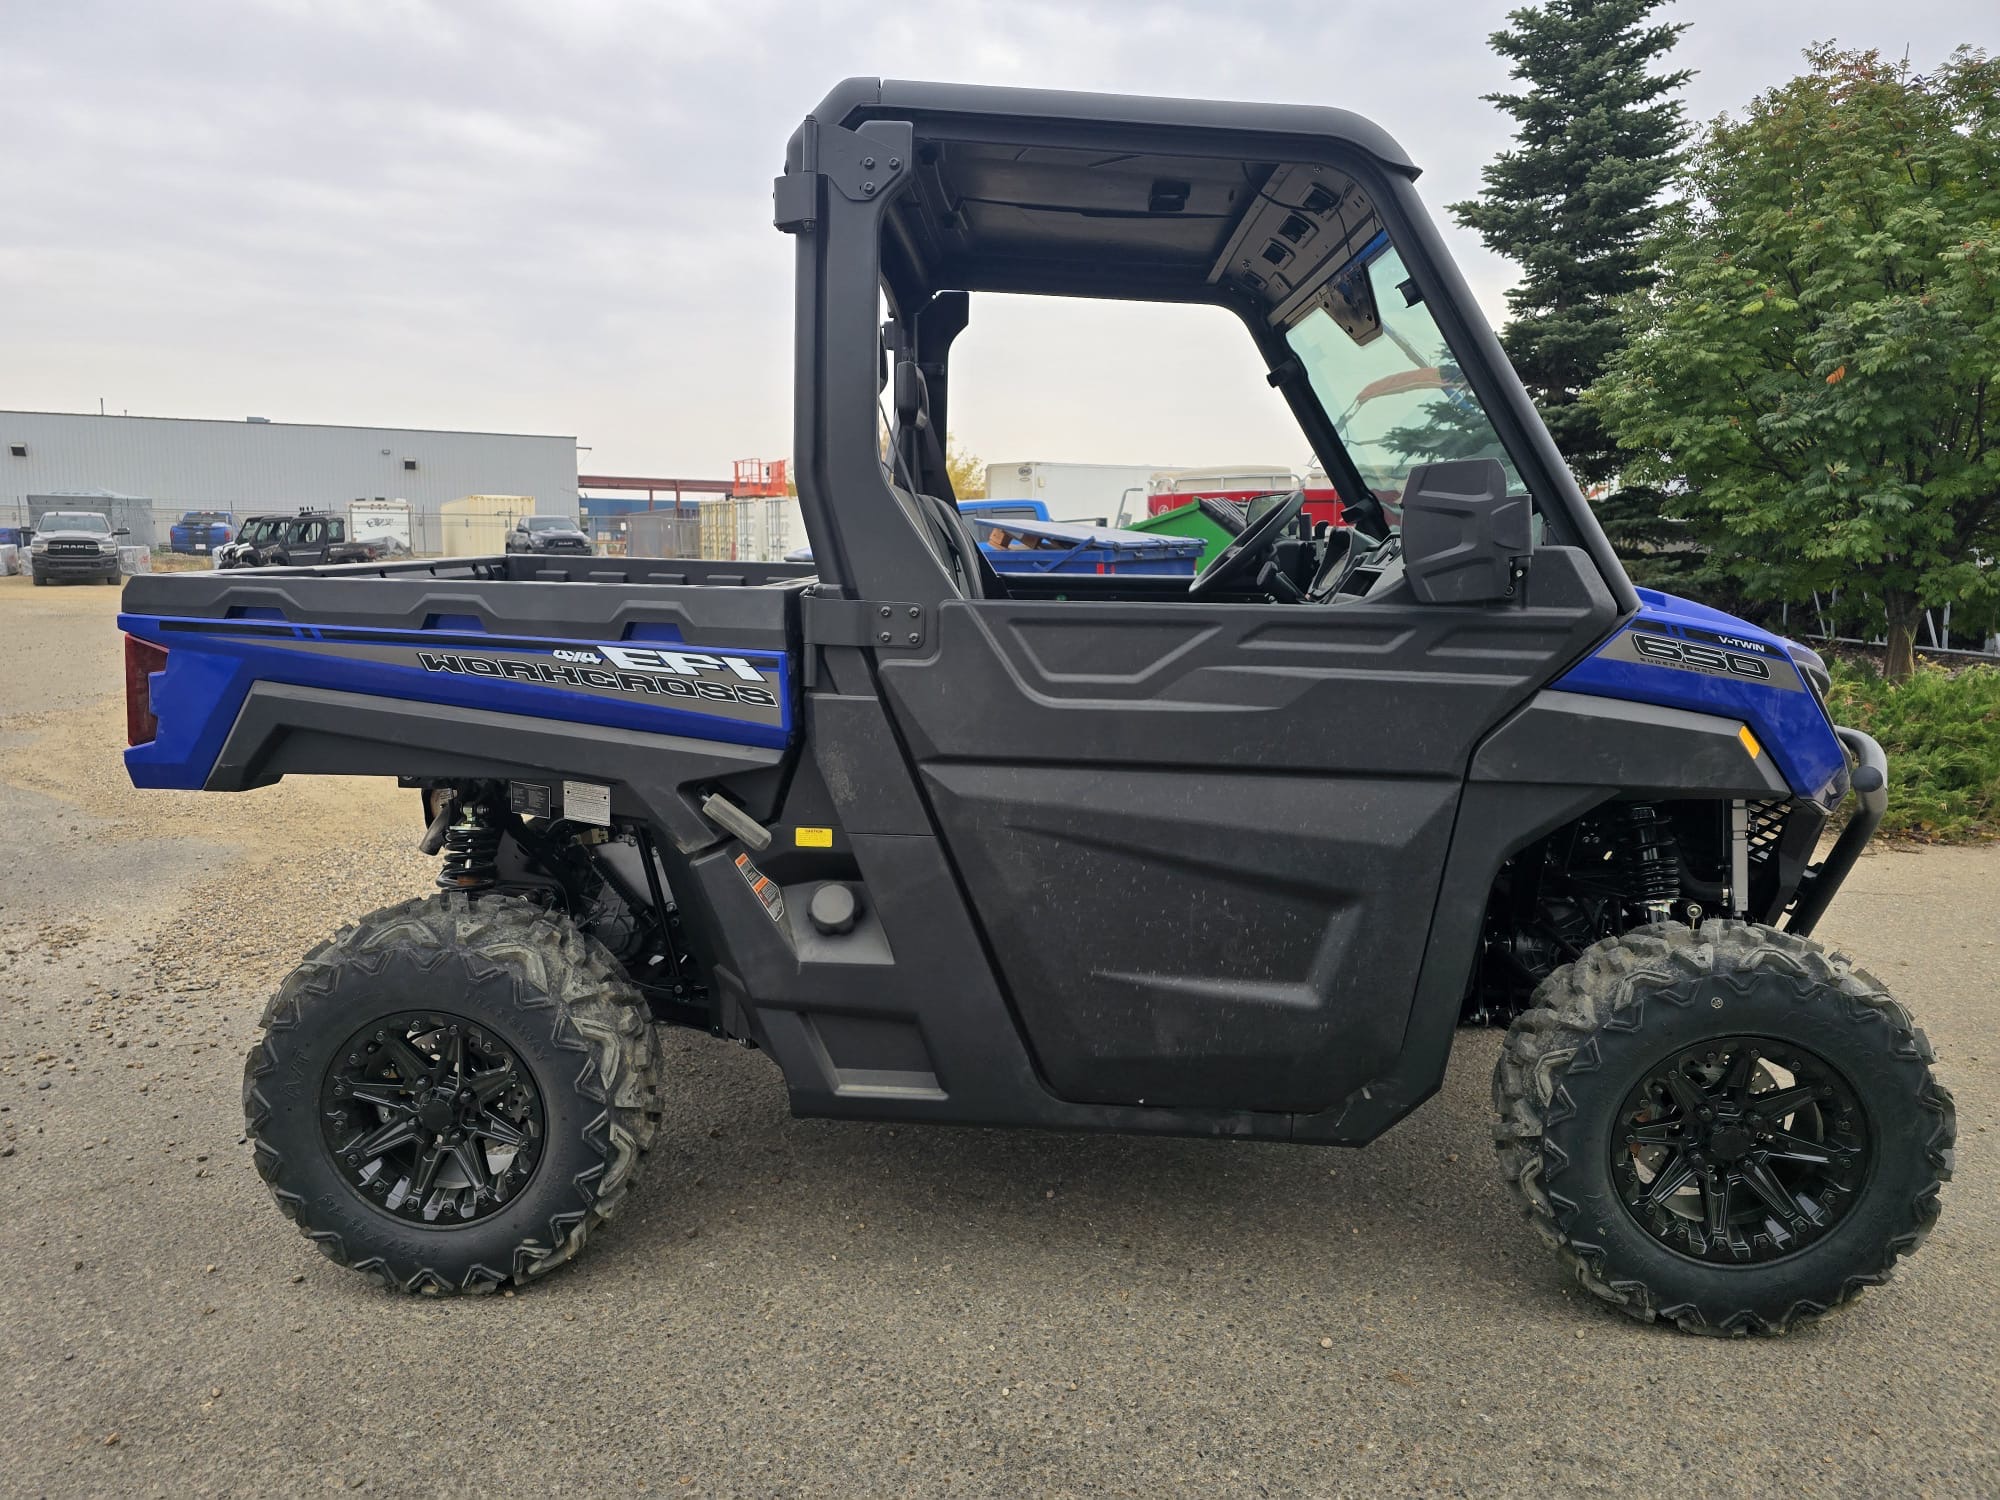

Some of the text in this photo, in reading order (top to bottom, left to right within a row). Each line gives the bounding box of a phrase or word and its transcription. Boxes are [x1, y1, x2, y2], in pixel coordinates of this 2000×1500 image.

[596, 646, 767, 682] EFI
[1632, 633, 1770, 680] 650
[1718, 635, 1765, 652] V-TWIN
[417, 651, 780, 707] WORKCROSS
